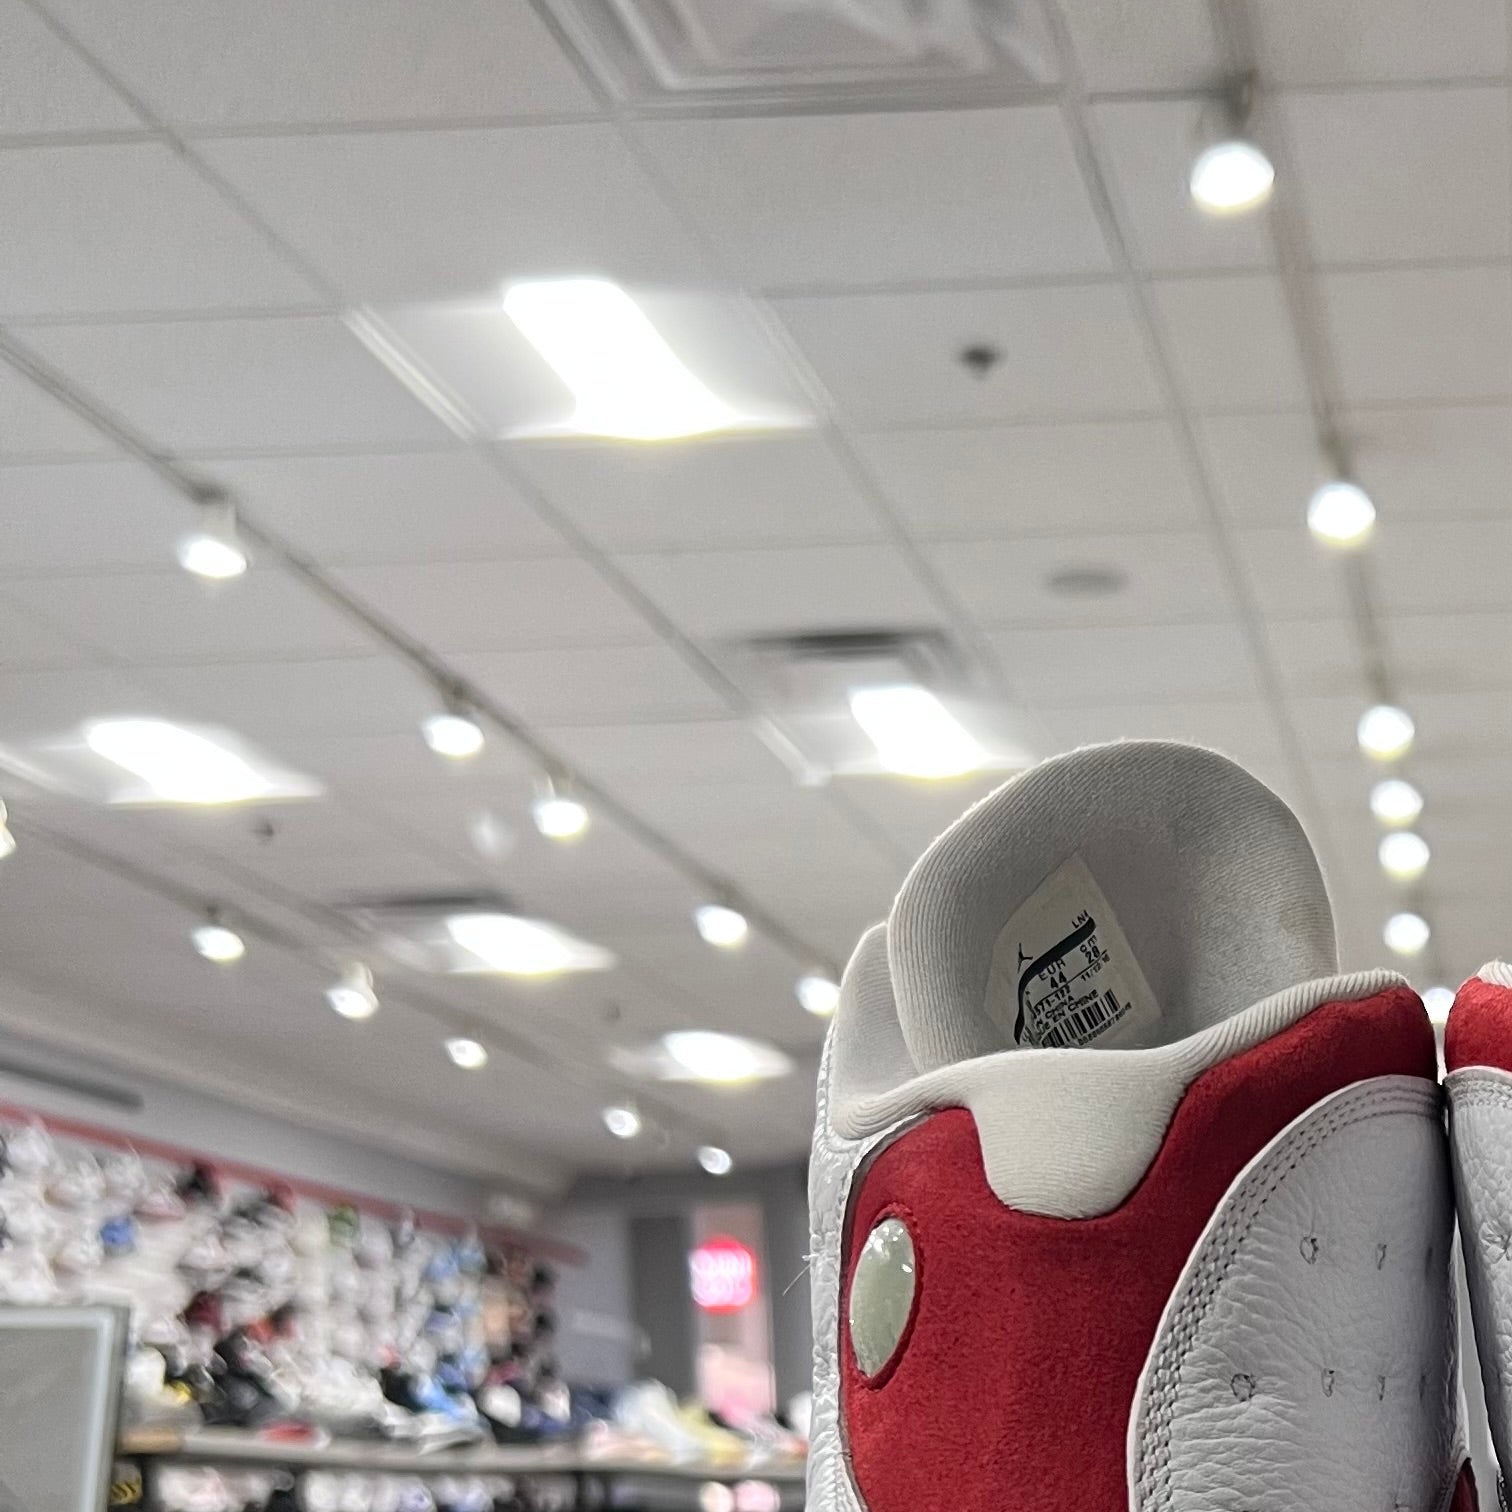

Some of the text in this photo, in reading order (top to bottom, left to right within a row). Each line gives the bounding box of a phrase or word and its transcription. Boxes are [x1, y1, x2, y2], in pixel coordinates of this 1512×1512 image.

[1084, 945, 1101, 965] 28
[1039, 958, 1066, 981] EUR
[1050, 971, 1067, 989] 44
